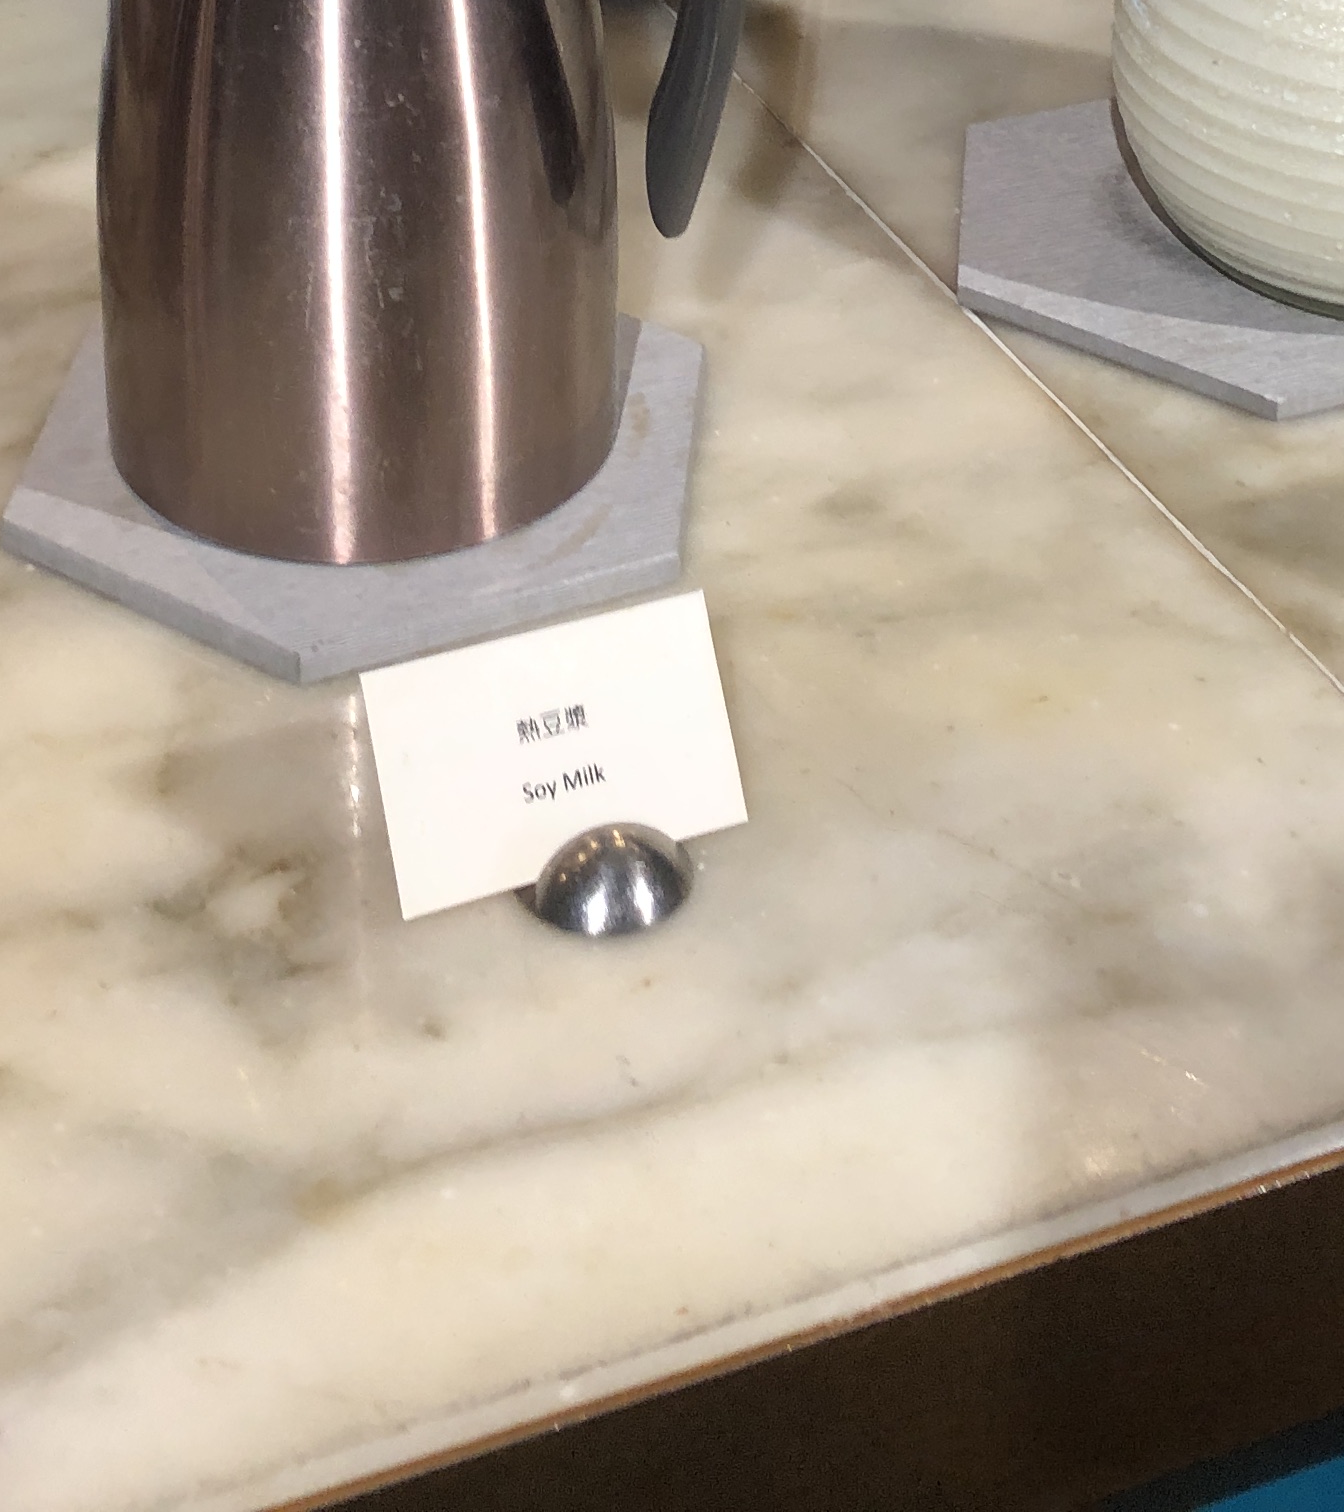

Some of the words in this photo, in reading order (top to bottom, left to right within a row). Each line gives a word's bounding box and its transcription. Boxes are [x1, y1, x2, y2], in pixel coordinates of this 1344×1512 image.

[516, 704, 589, 745] 熱豆漿
[522, 780, 557, 804] Soy
[562, 762, 606, 792] Milk
